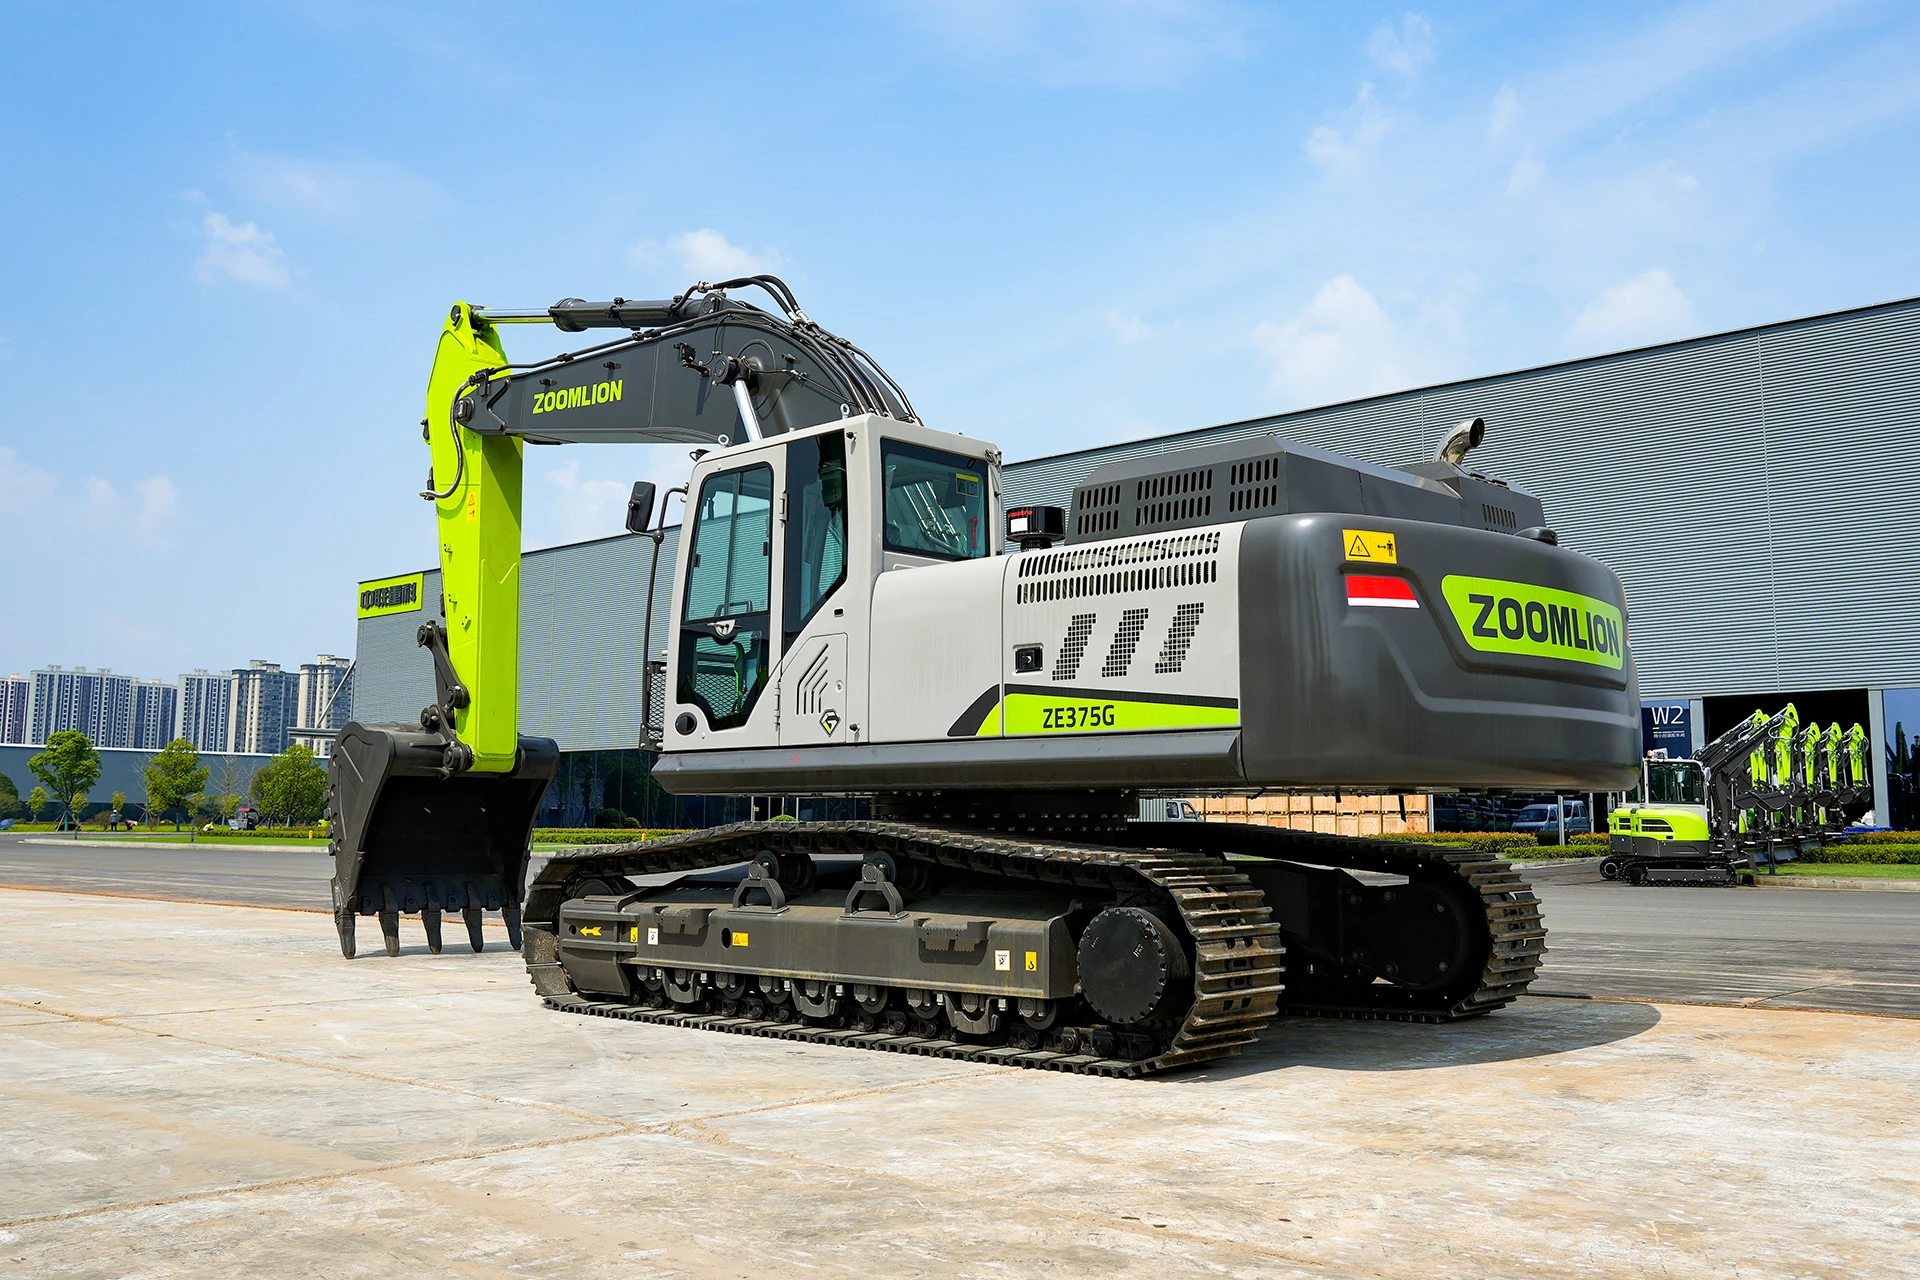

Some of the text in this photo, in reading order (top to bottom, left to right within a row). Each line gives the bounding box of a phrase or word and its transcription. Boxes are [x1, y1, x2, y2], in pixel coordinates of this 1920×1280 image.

[532, 379, 623, 414] ZOOMLION
[360, 582, 417, 610] 中联重科
[1468, 593, 1620, 658] ZOOMLION
[1043, 704, 1115, 728] ZE375G
[1651, 705, 1685, 725] W2
